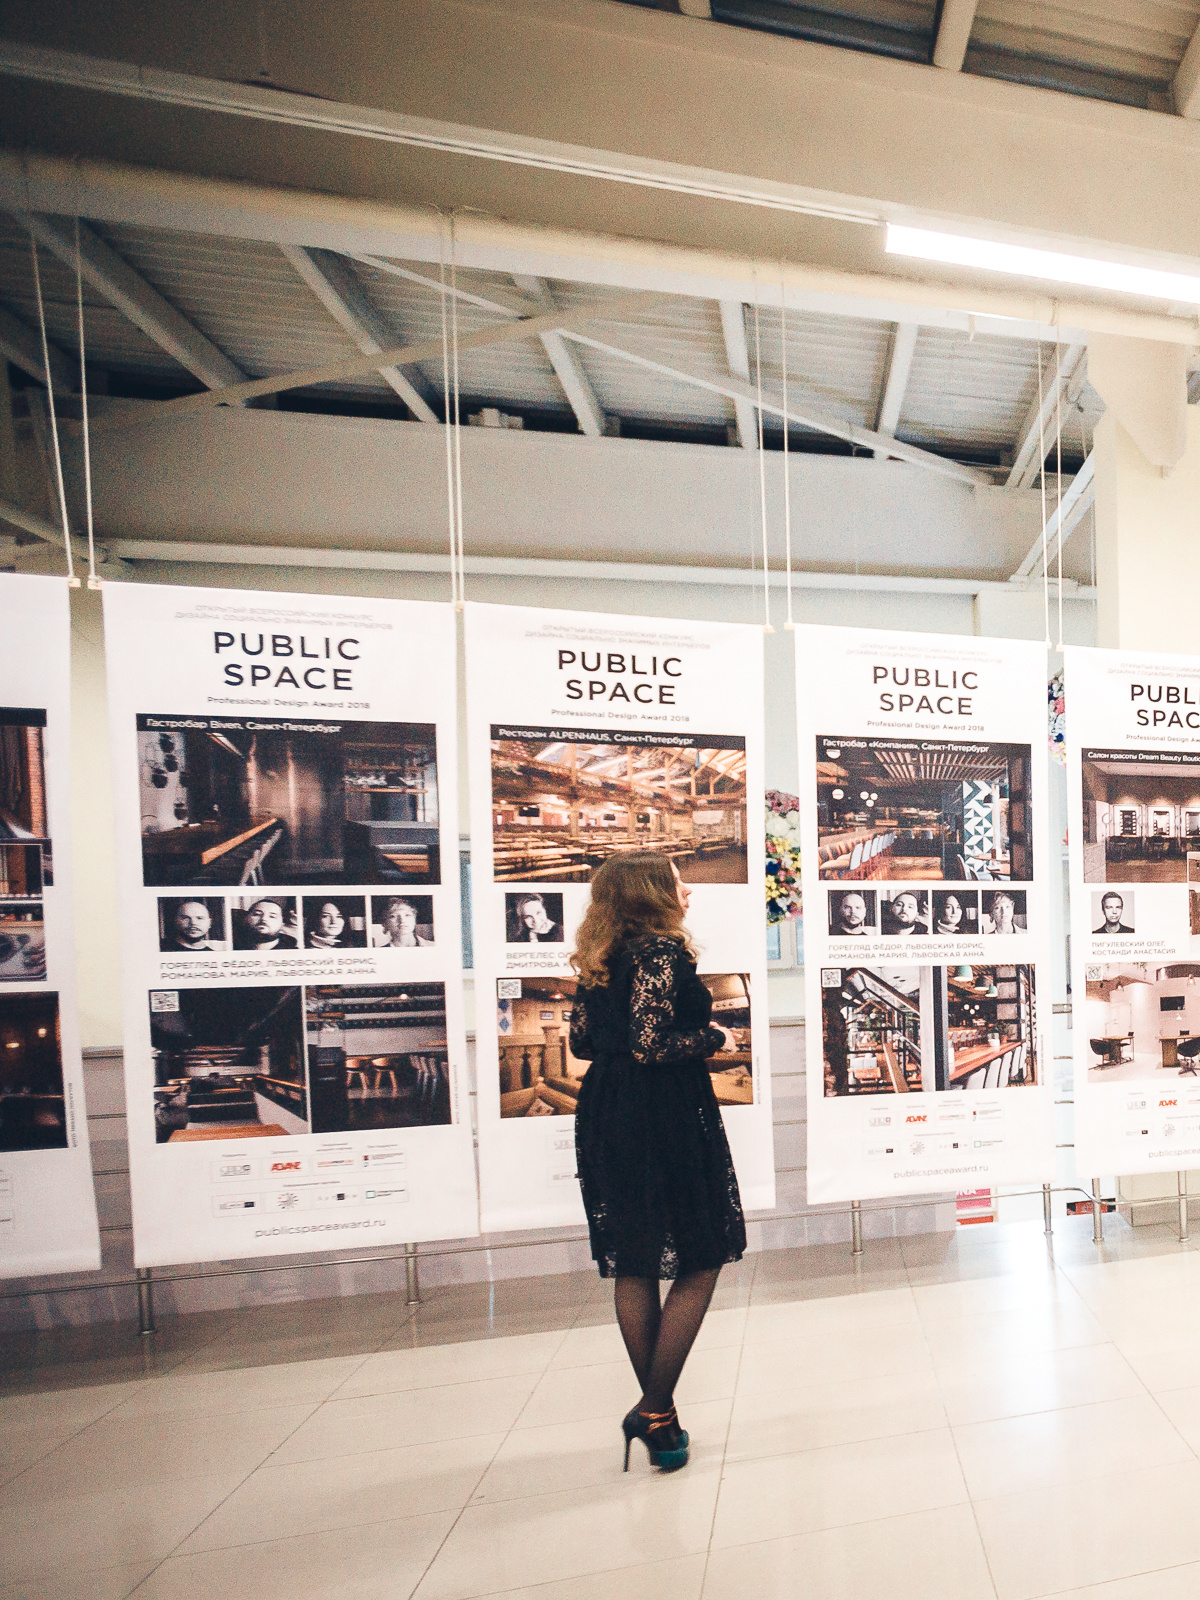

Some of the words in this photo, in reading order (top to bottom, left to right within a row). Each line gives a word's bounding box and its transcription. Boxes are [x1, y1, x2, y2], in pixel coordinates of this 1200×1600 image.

[213, 631, 361, 661] PUBLIC
[557, 649, 683, 677] PUBLIC
[223, 663, 354, 691] SPACE
[872, 665, 979, 690] PUBLIC
[565, 679, 676, 705] SPACE
[207, 696, 270, 706] Professional
[274, 698, 309, 708] Design
[313, 701, 344, 709] Award
[879, 693, 973, 716] SPACE
[551, 708, 605, 718] Professional
[608, 711, 638, 721] Design
[641, 713, 667, 721] Award
[670, 714, 690, 722] 2018
[146, 718, 207, 731] Гастробар
[867, 720, 913, 728] Professional
[915, 722, 940, 730] Design
[499, 728, 547, 740] Ресторан
[550, 730, 611, 742] ALPENHAUS,
[613, 733, 694, 746] Санкт-Петербург
[1126, 733, 1165, 741] Professional
[1167, 735, 1189, 743] Design
[822, 738, 867, 748] Гастробар
[921, 742, 990, 753] Санкт-Петербург
[1087, 751, 1110, 759] Салон
[1092, 940, 1145, 948] ПИГУЛЕВСКИЙ
[505, 960, 560, 969] ДМИТРОВА
[893, 1165, 989, 1179] publicspaceaward.ru
[255, 1217, 386, 1238] publicspaceaward.ru
